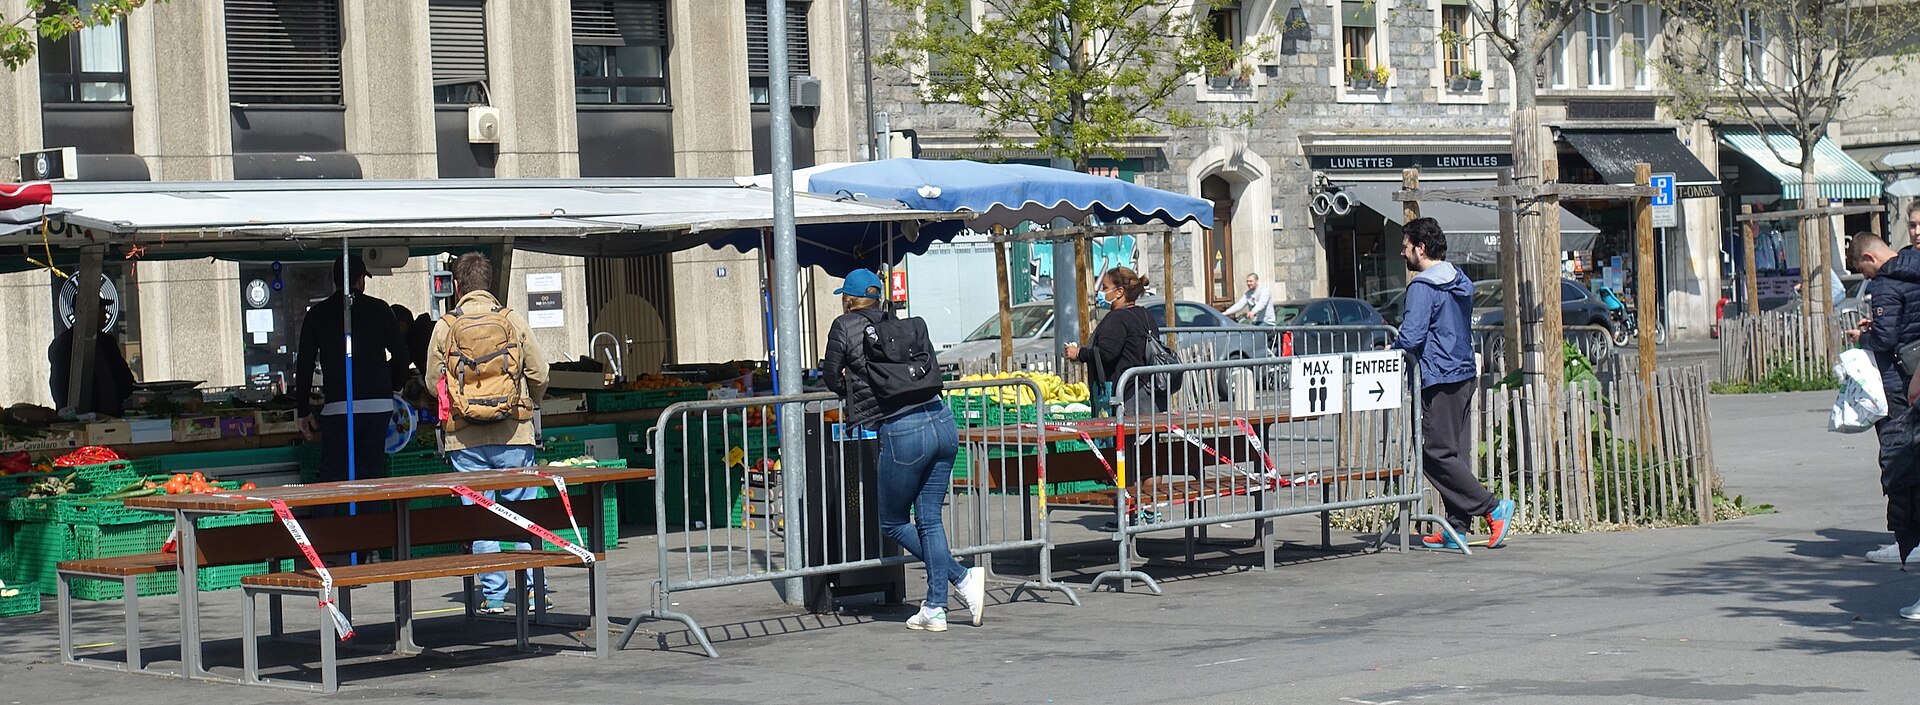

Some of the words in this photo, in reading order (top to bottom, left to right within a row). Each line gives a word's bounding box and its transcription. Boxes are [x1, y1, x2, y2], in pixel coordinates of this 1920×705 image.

[1330, 157, 1393, 169] LUNETTES
[1436, 156, 1498, 167] LENTILLES
[1303, 361, 1333, 376] MAX.
[1355, 359, 1399, 374] ENTREE
[23, 441, 58, 450] Cavallaro
